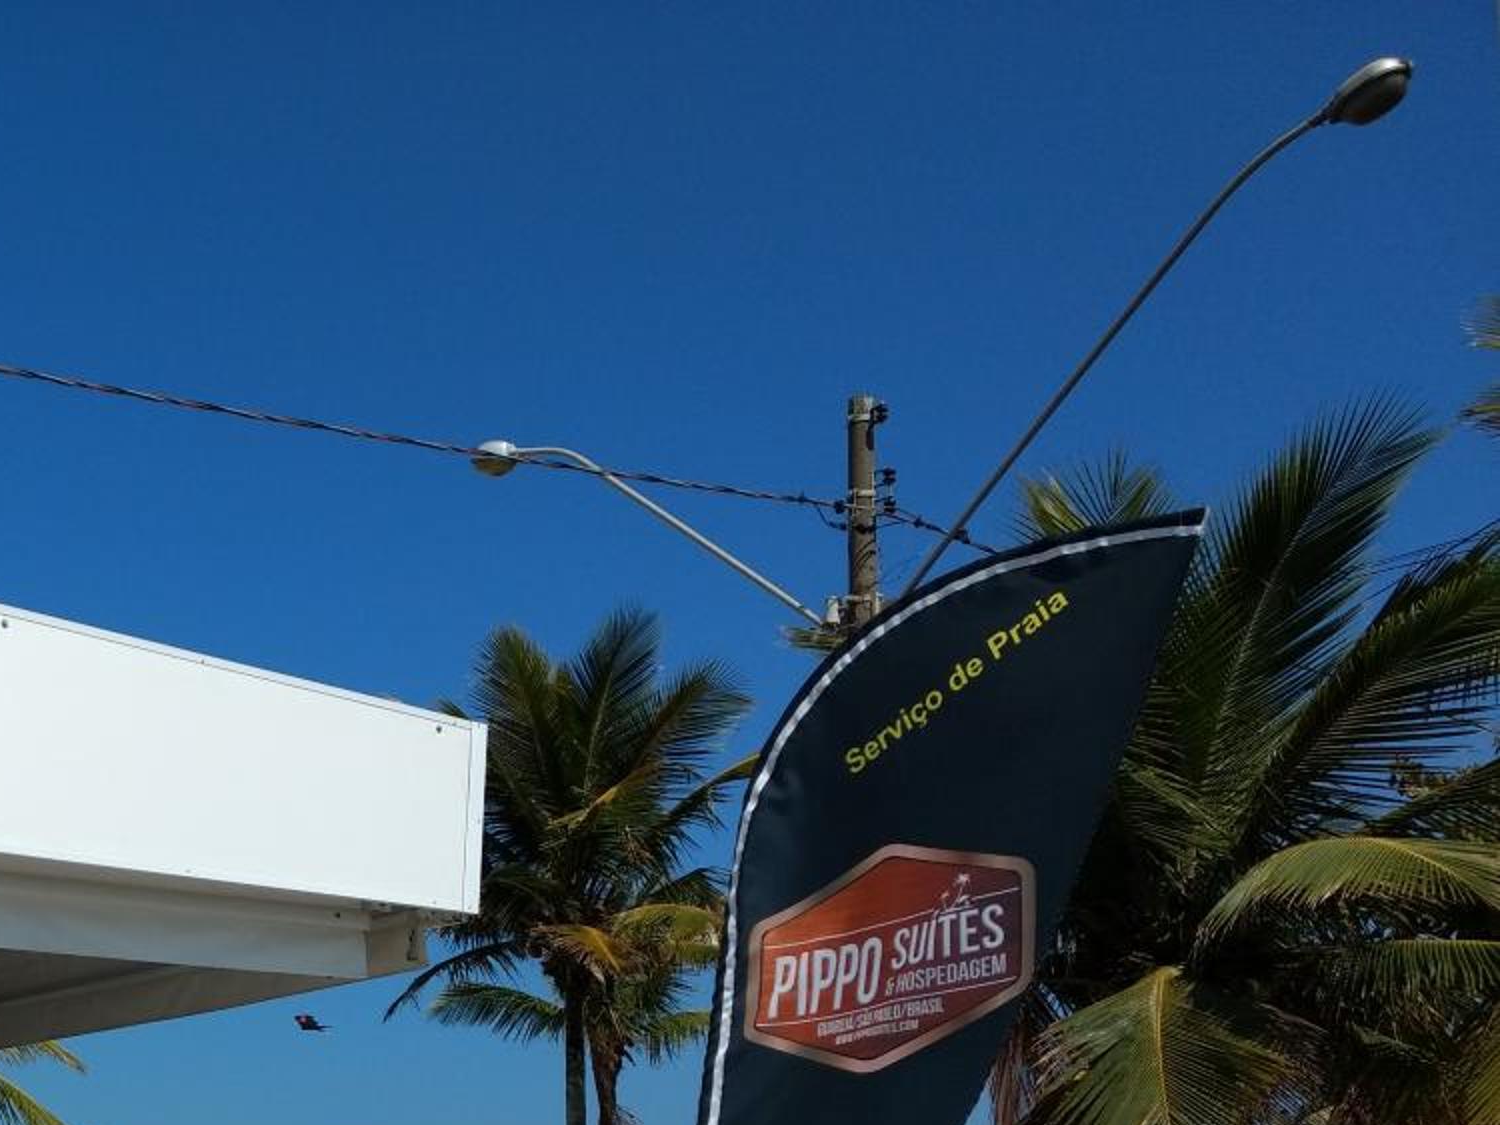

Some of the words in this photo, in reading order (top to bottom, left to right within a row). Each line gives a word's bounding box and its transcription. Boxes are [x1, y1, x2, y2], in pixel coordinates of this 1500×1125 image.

[845, 690, 943, 773] Serviço
[949, 657, 983, 691] de
[986, 591, 1069, 660] Praia
[768, 936, 883, 1019] PIPPO
[885, 977, 895, 997] &
[896, 953, 1007, 993] HOSPEDAGEM
